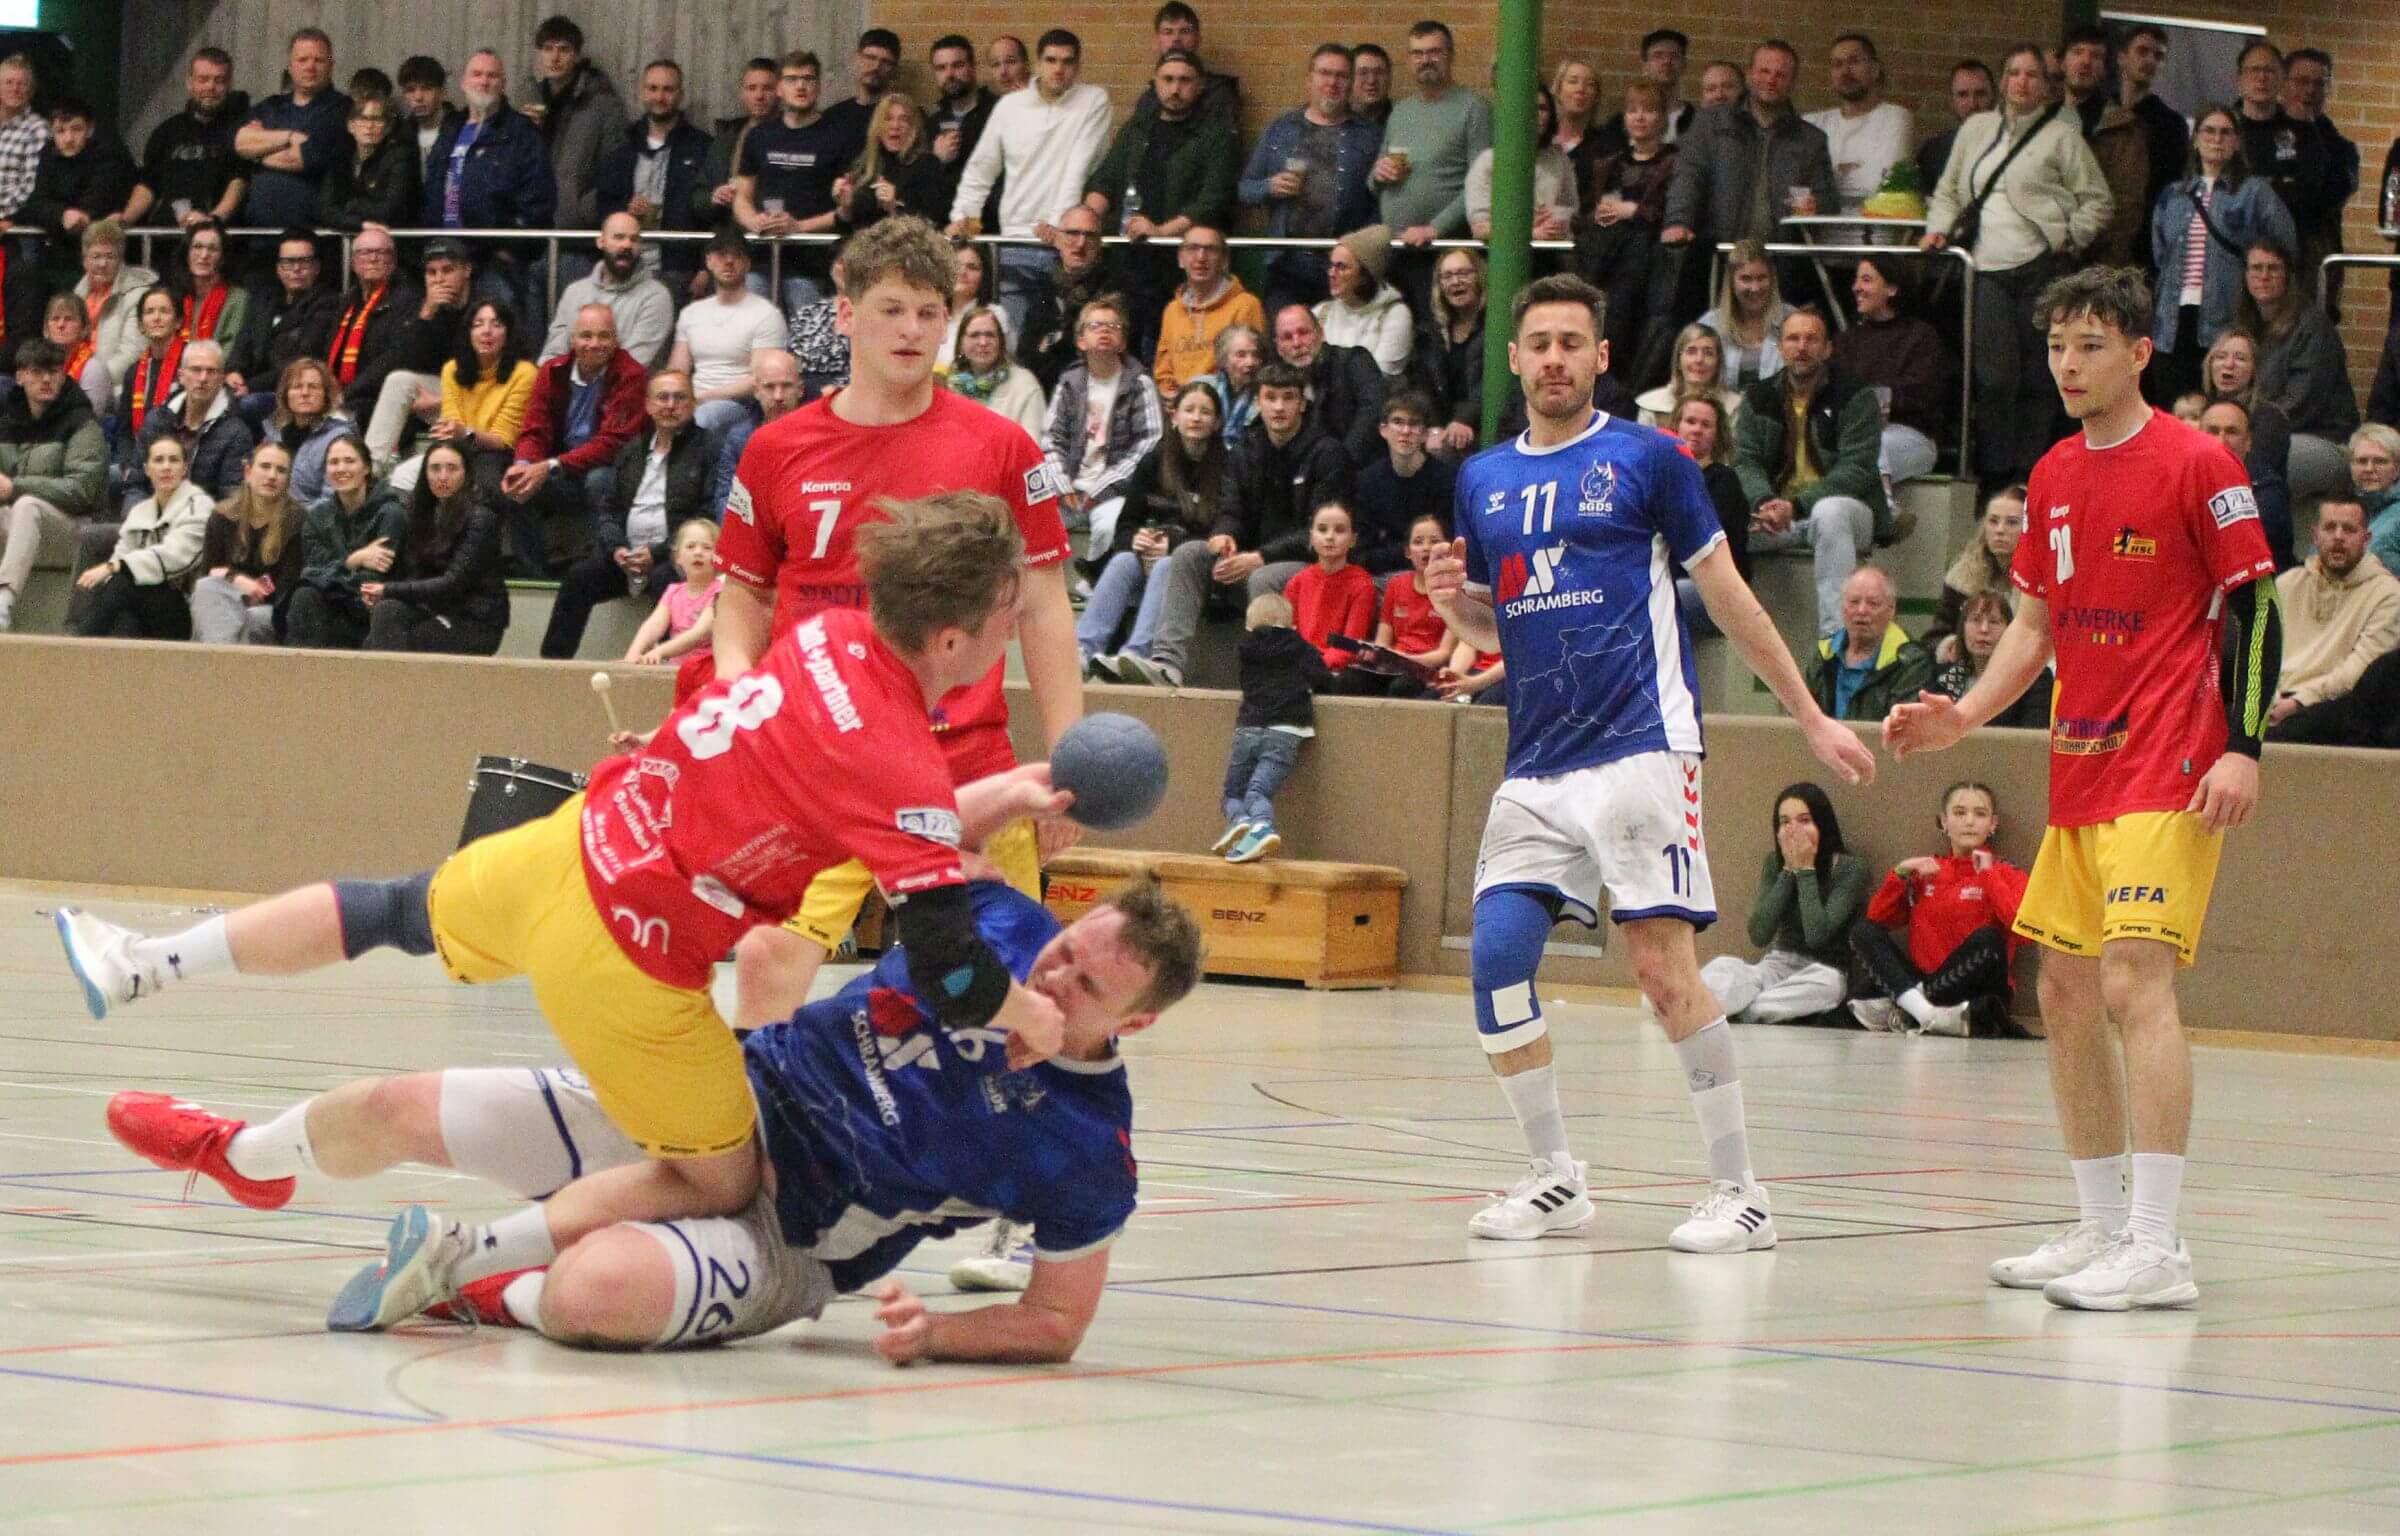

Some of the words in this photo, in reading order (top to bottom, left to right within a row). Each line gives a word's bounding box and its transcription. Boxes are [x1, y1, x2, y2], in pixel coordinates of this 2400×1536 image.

[801, 480, 852, 495] Kempa
[1520, 480, 1557, 536] 11
[1578, 501, 1613, 513] SGDS
[808, 499, 841, 561] 7
[1505, 590, 1604, 619] SCHRAMBERG
[676, 673, 784, 761] 8
[1662, 843, 1691, 899] 11
[1045, 884, 1098, 902] ENZ
[1211, 909, 1267, 923] BENZ
[2119, 923, 2152, 934] Kempa
[2052, 934, 2083, 951] Kempa
[695, 1255, 751, 1336] 26
